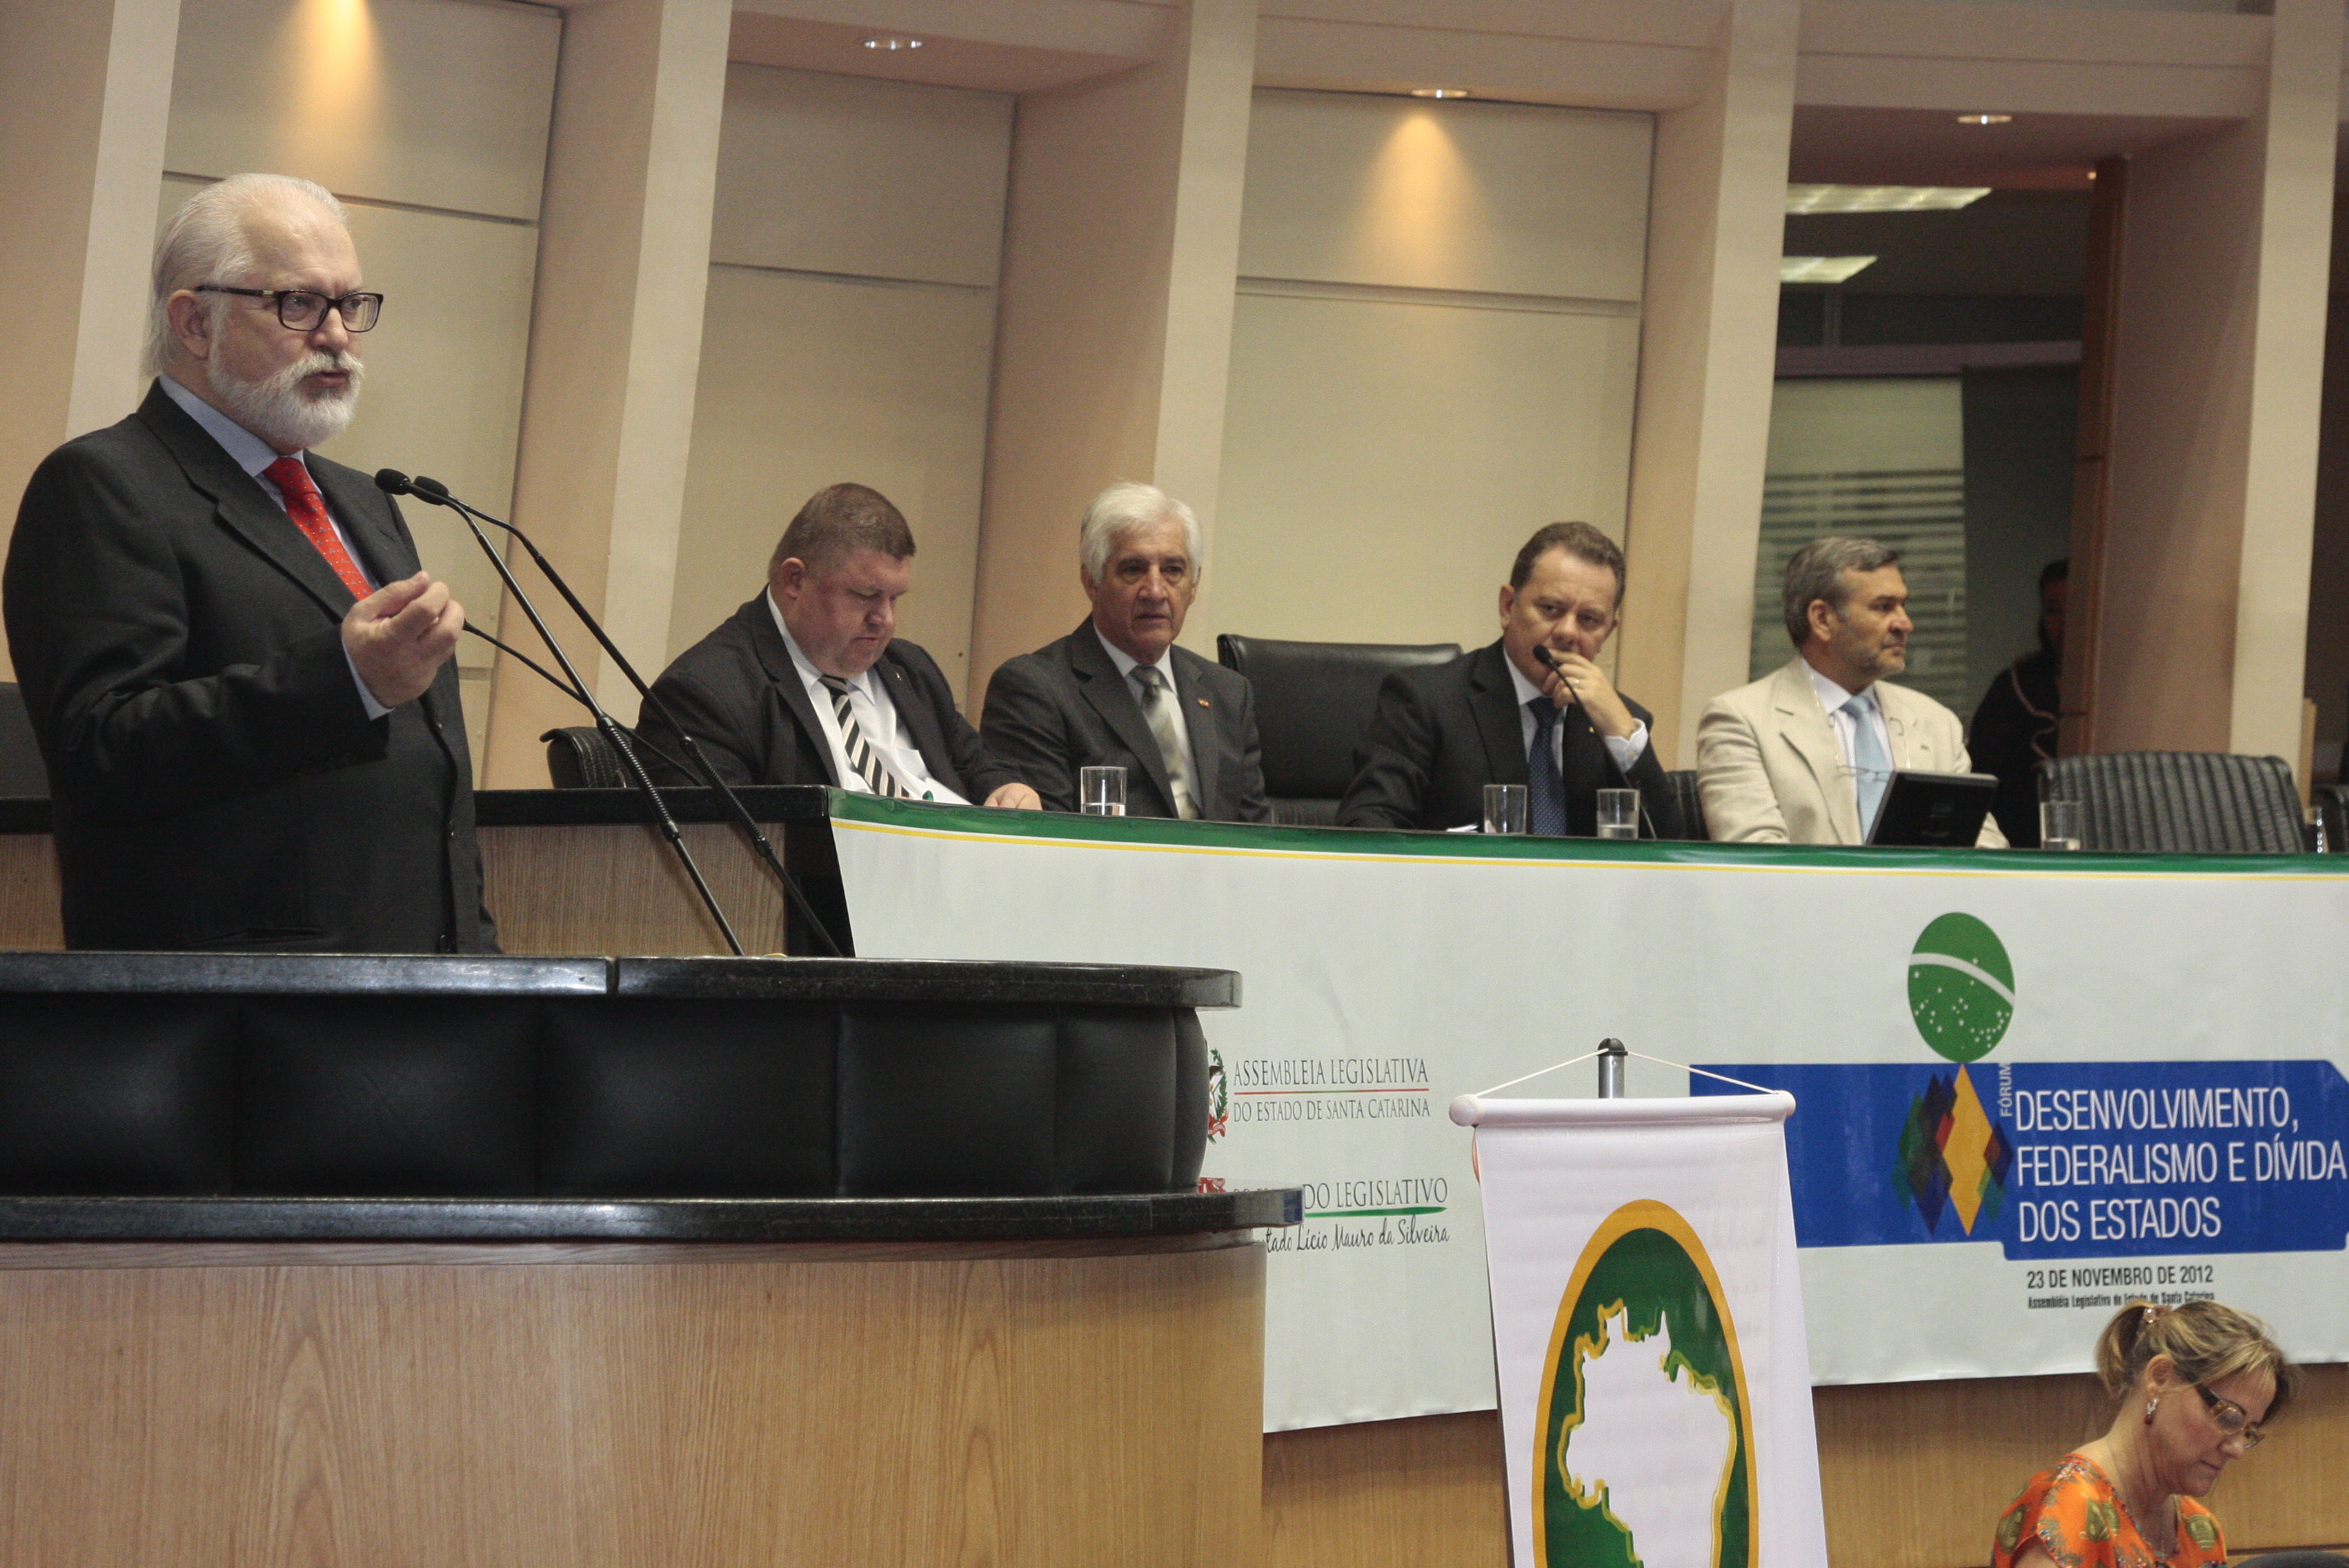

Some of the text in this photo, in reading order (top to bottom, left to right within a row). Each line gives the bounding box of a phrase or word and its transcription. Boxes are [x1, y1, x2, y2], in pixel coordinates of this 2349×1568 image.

[1233, 1058, 1428, 1086] ASSEMBLEIA LEGISLATIVA
[1233, 1098, 1431, 1123] DO ESTADO DE SANTA CATARINA
[2015, 1087, 2299, 1133] DESENVOLVIMENTO,
[2017, 1133, 2348, 1187] FEDERALISMO E DÍVIDA
[1303, 1178, 1448, 1209] DO LEGISLATIVO
[1296, 1224, 1327, 1251] Lício
[1331, 1223, 1374, 1252] Mauro
[1379, 1218, 1395, 1244] da
[1397, 1214, 1451, 1244] Silveira
[2019, 1196, 2221, 1243] DOS ESTADOS
[2027, 1264, 2214, 1289] 23 DE NOVEMBRO DE 2012
